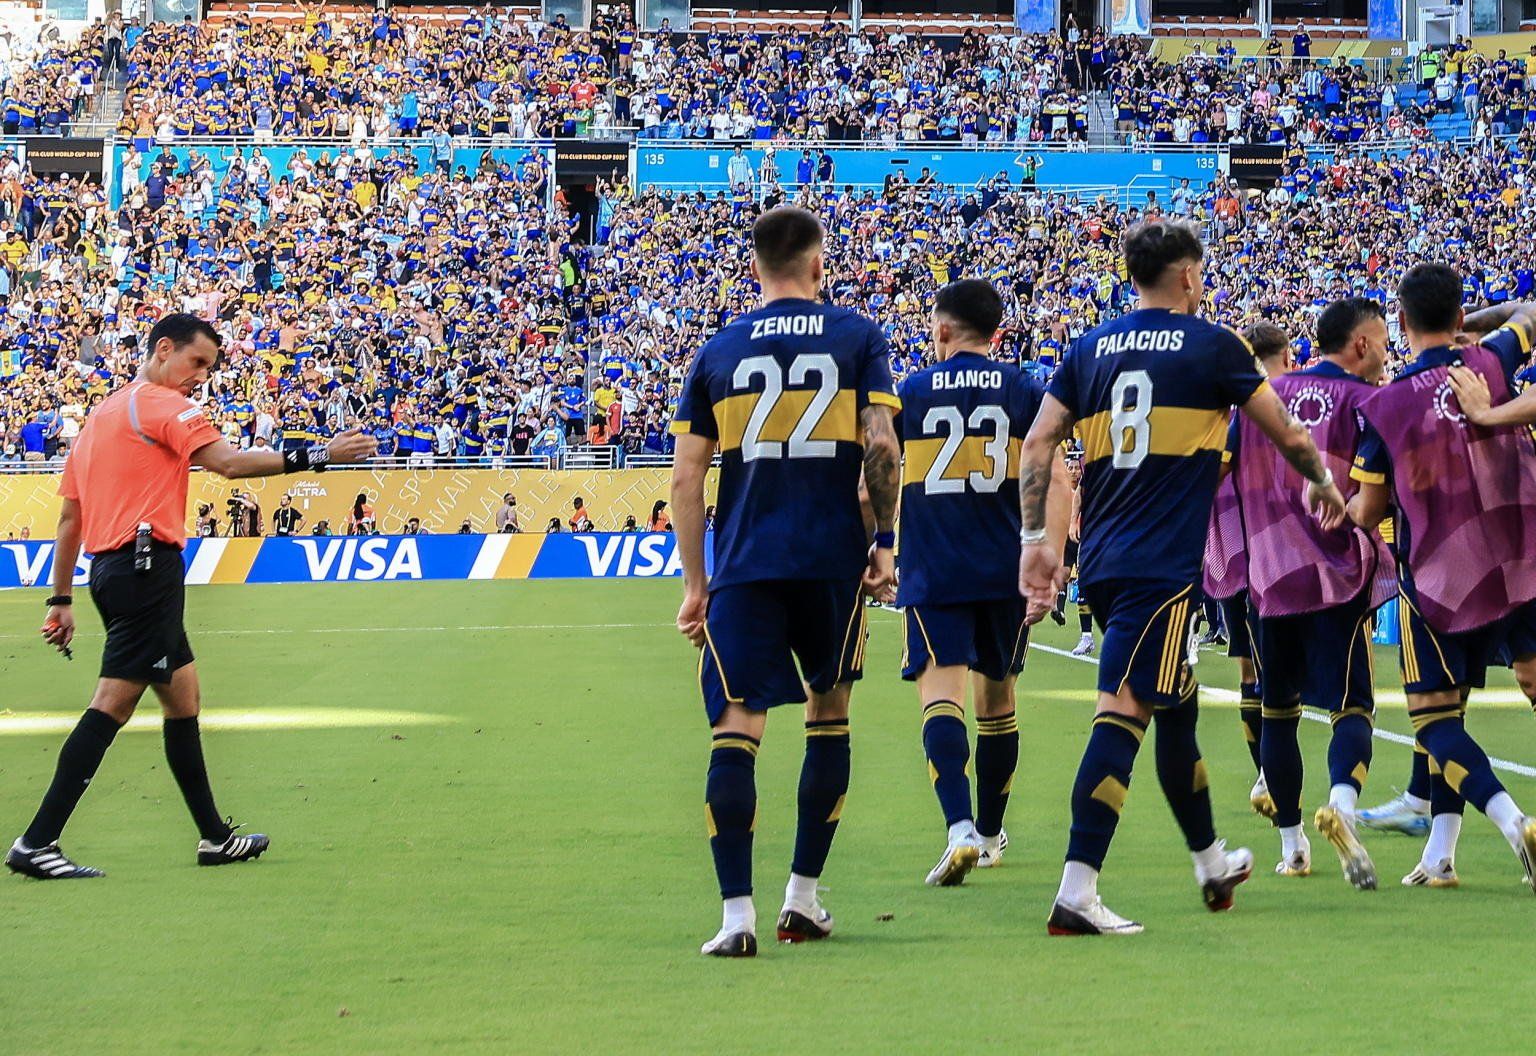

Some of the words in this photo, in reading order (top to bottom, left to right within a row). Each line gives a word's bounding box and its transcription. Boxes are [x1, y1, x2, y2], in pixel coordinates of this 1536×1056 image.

[644, 154, 664, 164] 135
[1196, 158, 1214, 168] 135
[750, 314, 824, 340] ZENON
[1095, 328, 1186, 359] PALACIOS
[932, 369, 1002, 392] BLANCO
[1411, 367, 1450, 392] AGU
[733, 353, 839, 463] 22
[1109, 369, 1154, 470] 8
[922, 404, 1011, 495] 23
[287, 488, 327, 497] ULTRA
[294, 538, 423, 581] VISA
